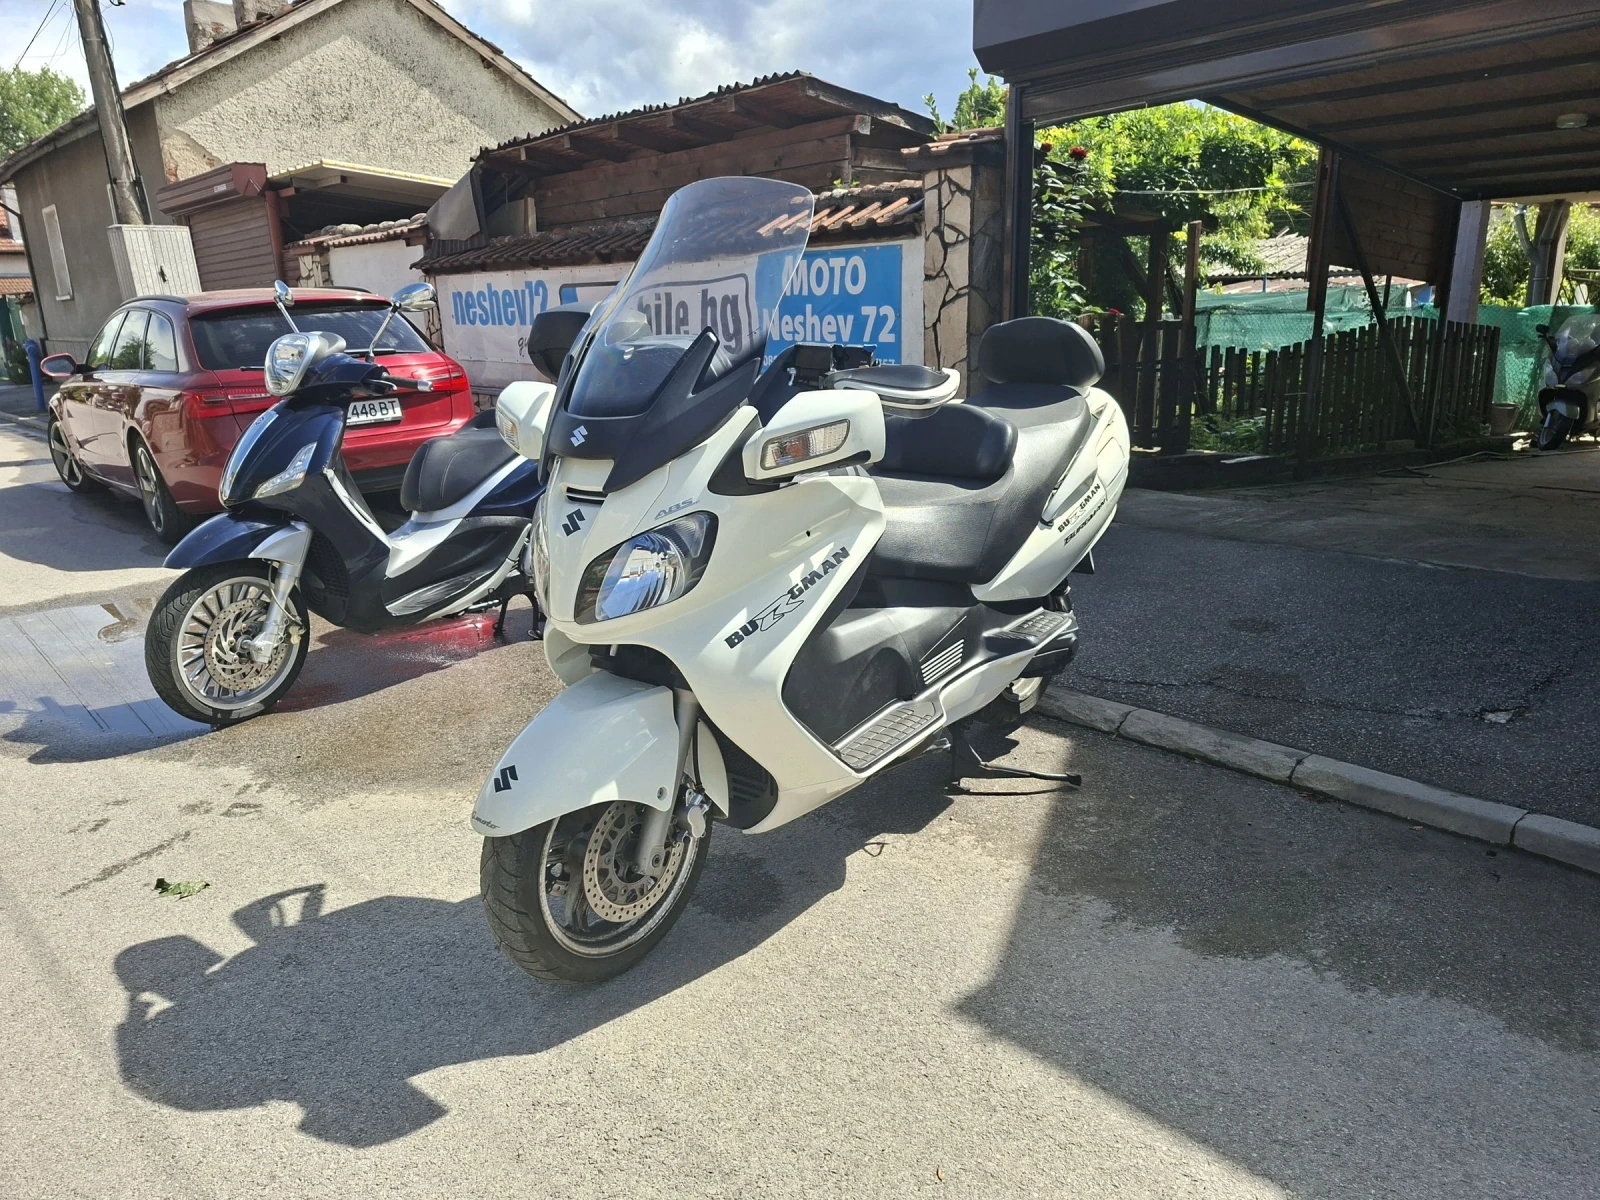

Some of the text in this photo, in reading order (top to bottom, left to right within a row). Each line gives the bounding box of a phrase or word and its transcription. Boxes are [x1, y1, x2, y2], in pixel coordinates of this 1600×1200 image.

[782, 255, 867, 297] MOTO
[763, 303, 896, 343] Neshev 72
[347, 400, 397, 419] 448 BT
[724, 546, 850, 649] BURGMAN
